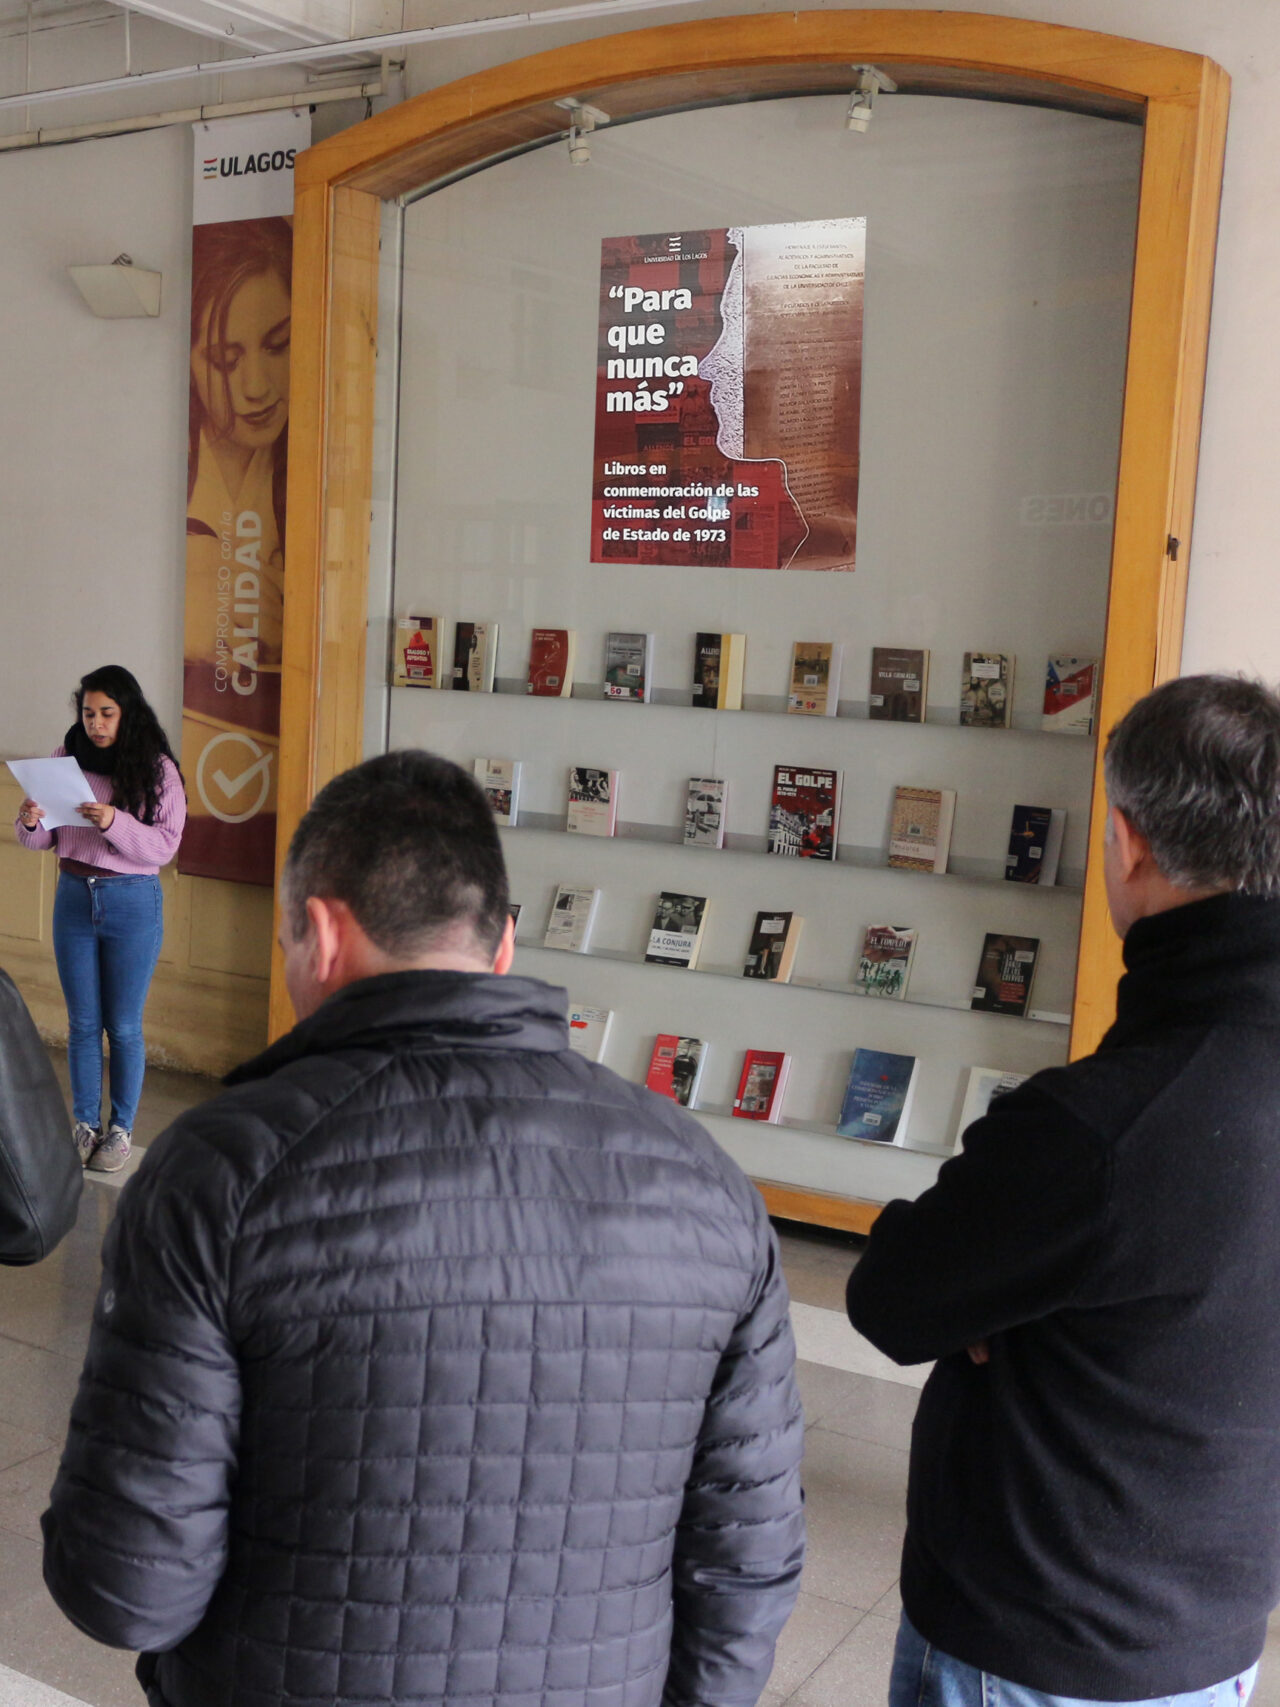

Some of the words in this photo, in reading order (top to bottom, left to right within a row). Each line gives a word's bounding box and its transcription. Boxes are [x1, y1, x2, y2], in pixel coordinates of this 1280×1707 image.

[220, 149, 297, 177] ULAGOS
[608, 285, 692, 313] “Para
[607, 323, 666, 353] que
[607, 355, 699, 379] nunca
[606, 380, 685, 412] más”
[604, 461, 647, 475] Libros
[649, 464, 667, 475] en
[603, 483, 713, 497] conmemoración
[716, 483, 735, 497] de
[737, 483, 760, 497] las
[220, 511, 232, 526] la
[603, 504, 660, 519] víctimas
[663, 505, 685, 519] del
[688, 506, 731, 522] Golpe
[221, 529, 232, 560] con
[603, 527, 620, 540] de
[623, 528, 669, 541] Estado
[672, 529, 691, 541] de
[694, 529, 726, 542] 1973
[231, 510, 262, 696] CALIDAD
[215, 566, 231, 692] COMPROMISO
[778, 772, 792, 785] EL
[795, 774, 833, 789] GOLPE
